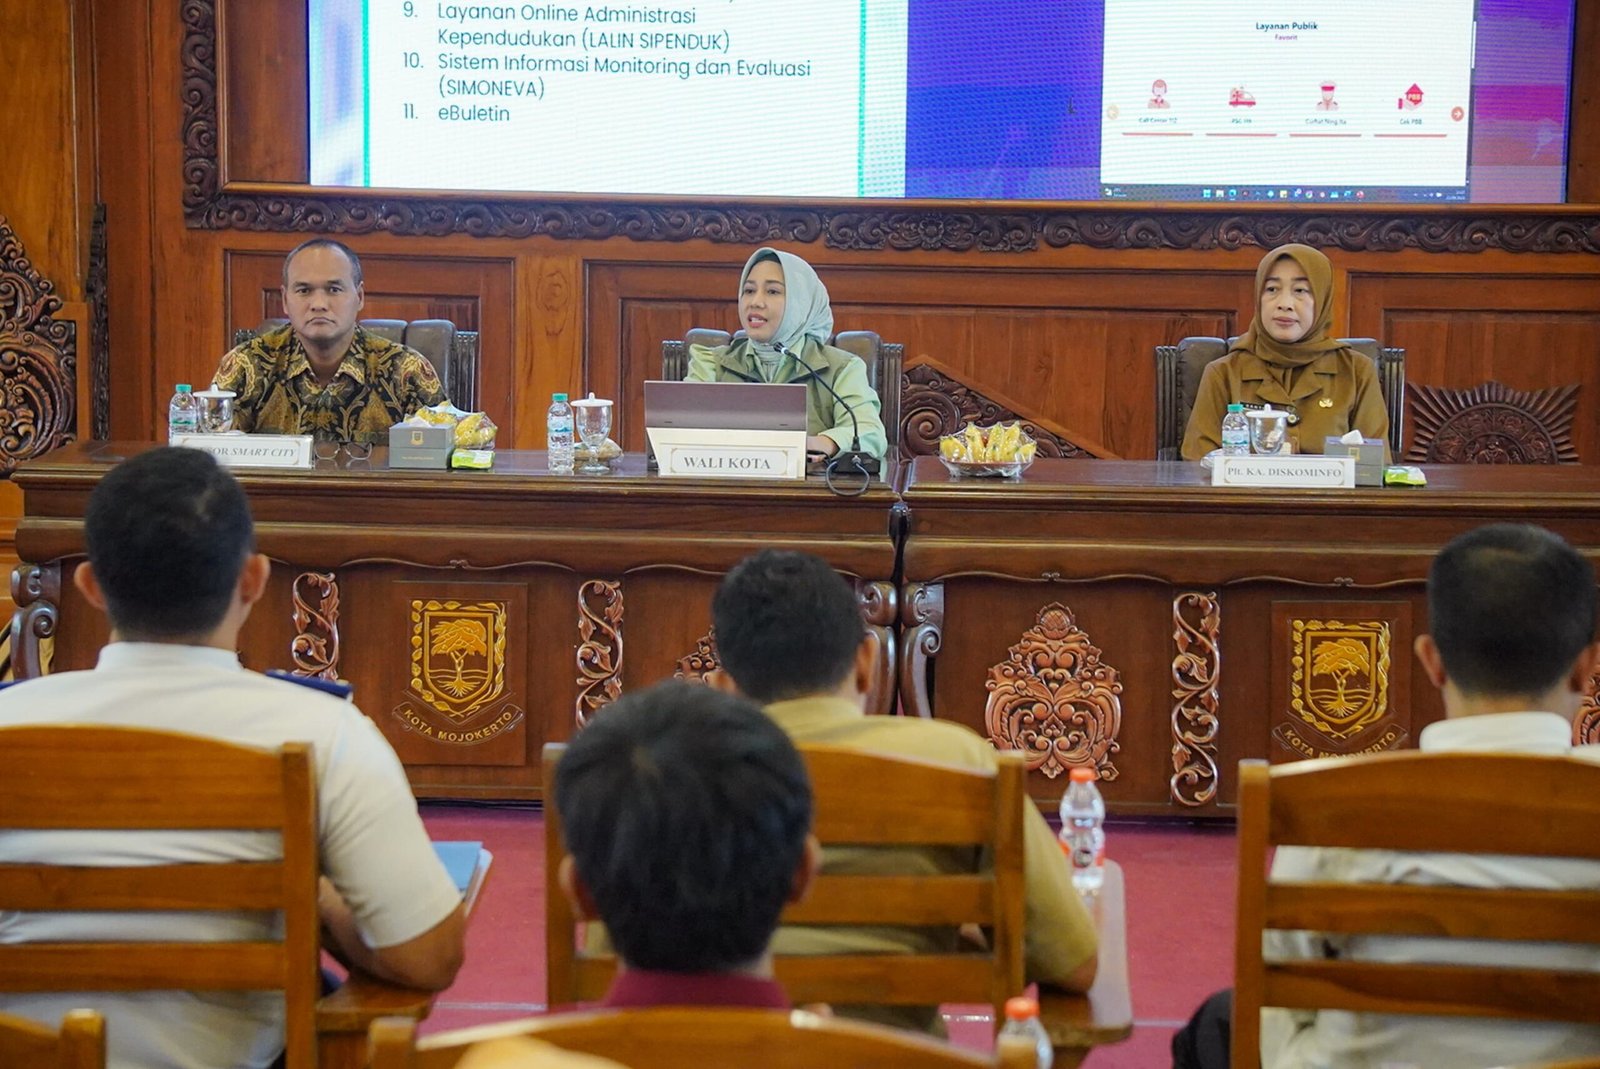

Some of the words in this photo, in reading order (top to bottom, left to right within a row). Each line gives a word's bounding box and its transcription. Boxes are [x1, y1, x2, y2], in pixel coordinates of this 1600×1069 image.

[403, 1, 418, 18] 9.
[438, 3, 516, 24] Layanan
[521, 4, 578, 21] Online
[584, 5, 696, 24] Administrasi
[1255, 22, 1290, 32] Layanan
[1292, 22, 1318, 30] Publik
[438, 28, 576, 49] Kependudukan
[582, 27, 634, 51] (LALIN
[640, 29, 730, 54] SIPENDUK)
[403, 52, 424, 69] 10.
[438, 52, 499, 70] Sistem
[504, 54, 589, 72] Informasi
[594, 56, 690, 80] Monitoring
[695, 59, 731, 75] dan
[737, 60, 811, 77] Evaluasi
[439, 74, 545, 100] (SIMONEVA)
[403, 103, 418, 120] 11.
[438, 104, 510, 121] eBuletin
[231, 447, 268, 457] SMART
[270, 448, 296, 457] CITY
[684, 457, 723, 469] WALI
[728, 457, 770, 470] KOTA
[1246, 467, 1265, 477] KA.
[1268, 468, 1342, 478] DISKOMINFO
[404, 709, 432, 737] KOTA
[437, 711, 513, 743] MOJOKERTO
[1284, 729, 1315, 757] KOTA
